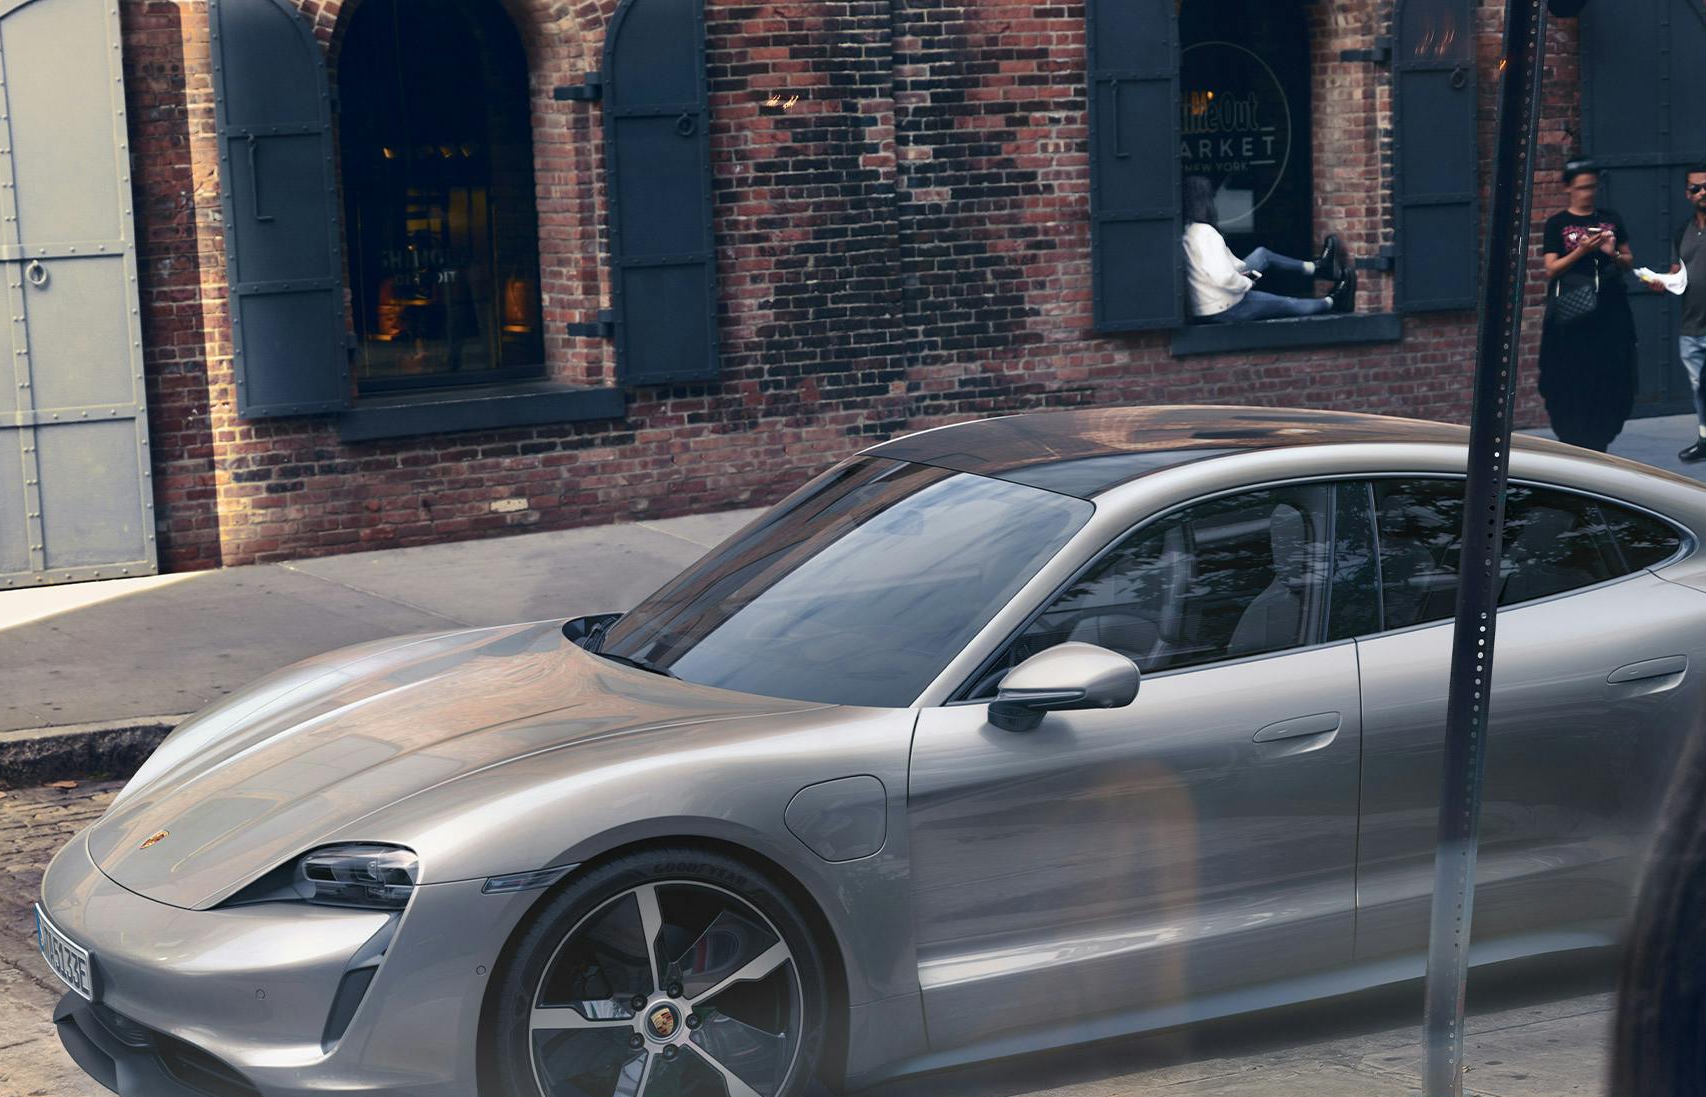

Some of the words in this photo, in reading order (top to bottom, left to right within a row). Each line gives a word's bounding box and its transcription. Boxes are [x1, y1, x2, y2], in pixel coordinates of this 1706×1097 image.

[1180, 135, 1275, 159] ARKET
[1216, 160, 1249, 172] YORK
[653, 862, 748, 888] GOODYEAR
